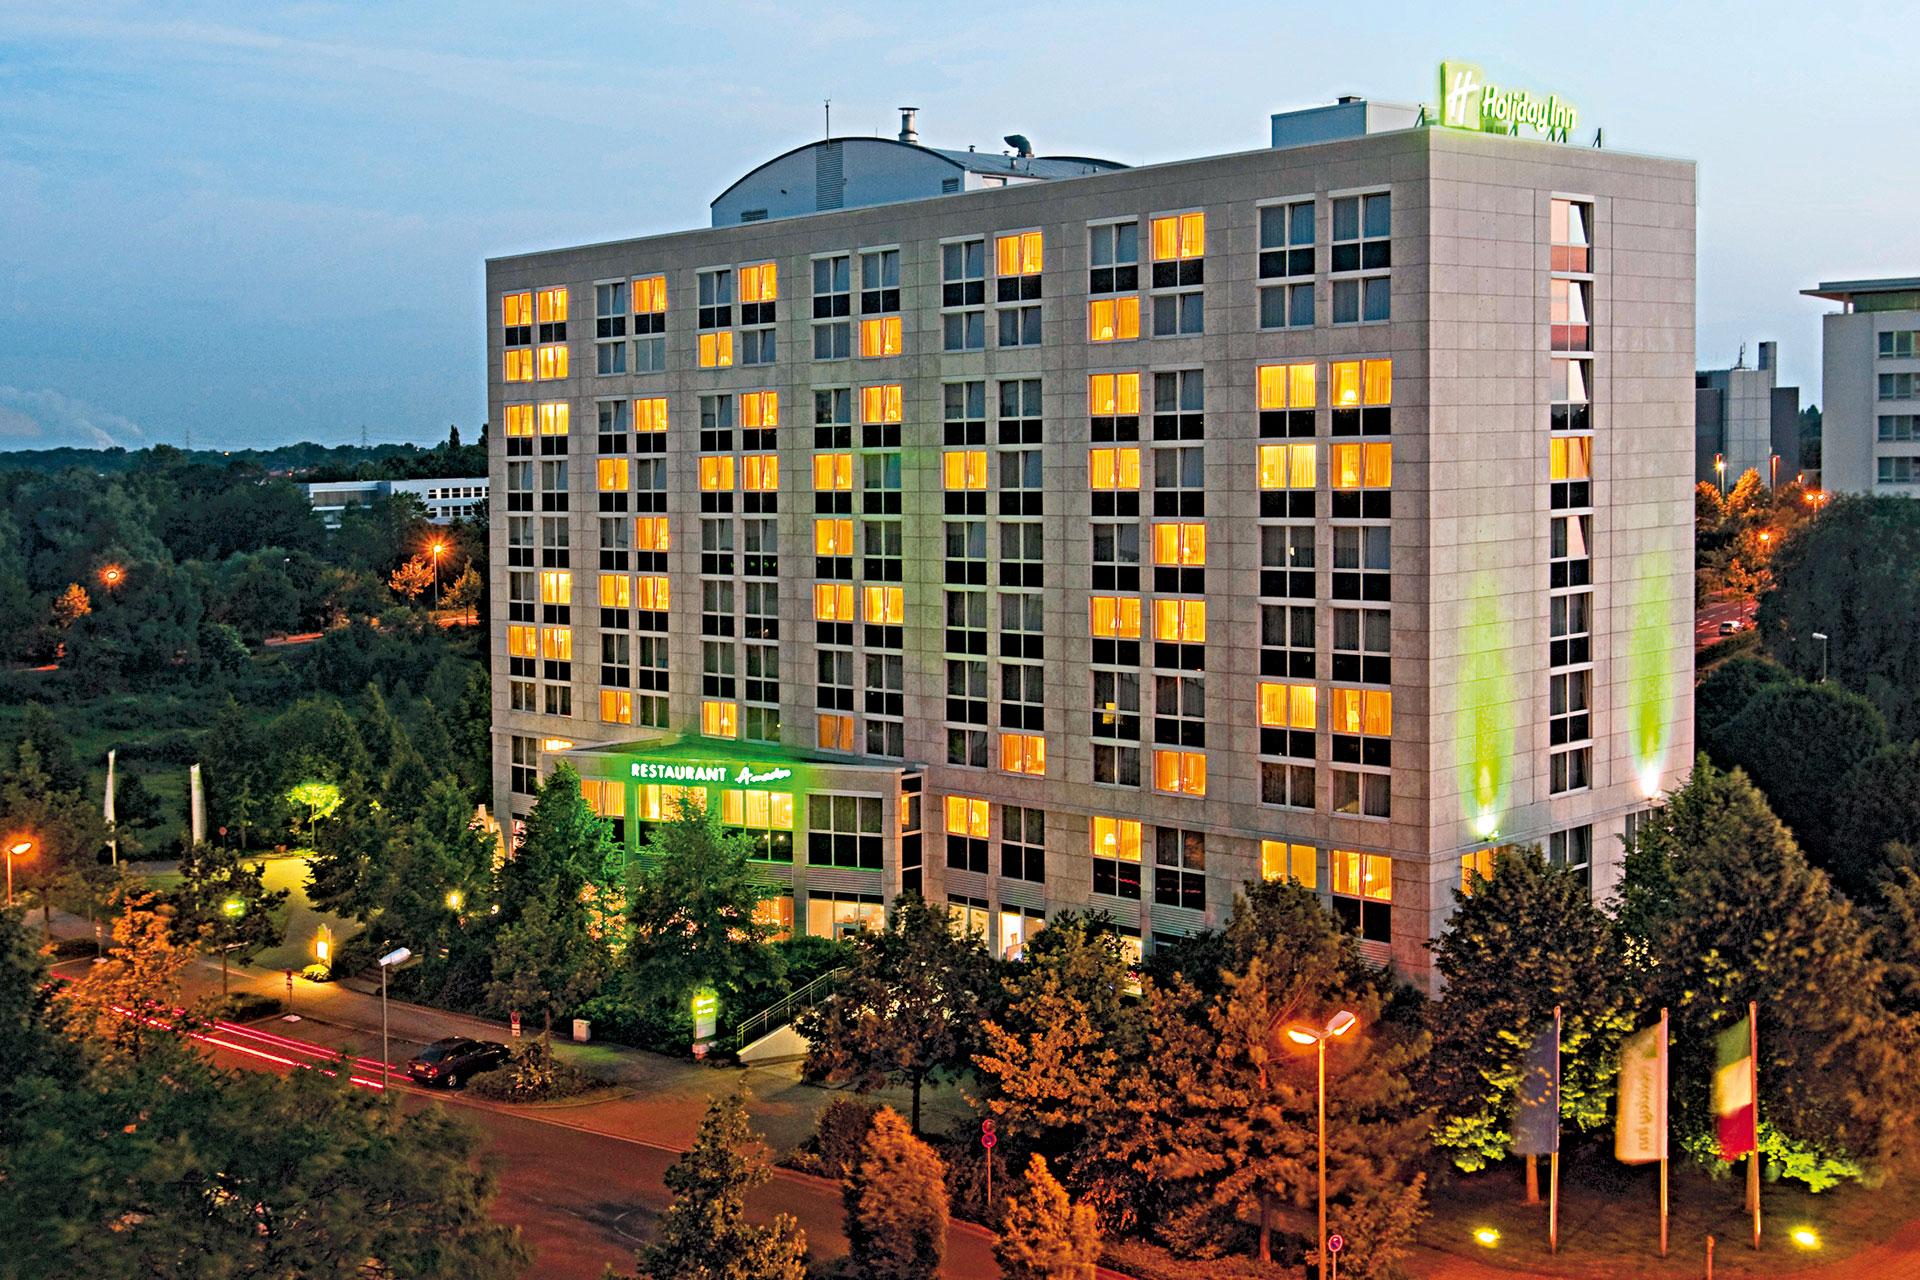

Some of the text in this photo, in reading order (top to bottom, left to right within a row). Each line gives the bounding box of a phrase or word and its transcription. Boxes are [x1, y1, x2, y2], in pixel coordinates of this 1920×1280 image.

[1447, 71, 1479, 124] H
[1482, 86, 1578, 132] Holiday Inn
[631, 763, 727, 782] RESTAURANT
